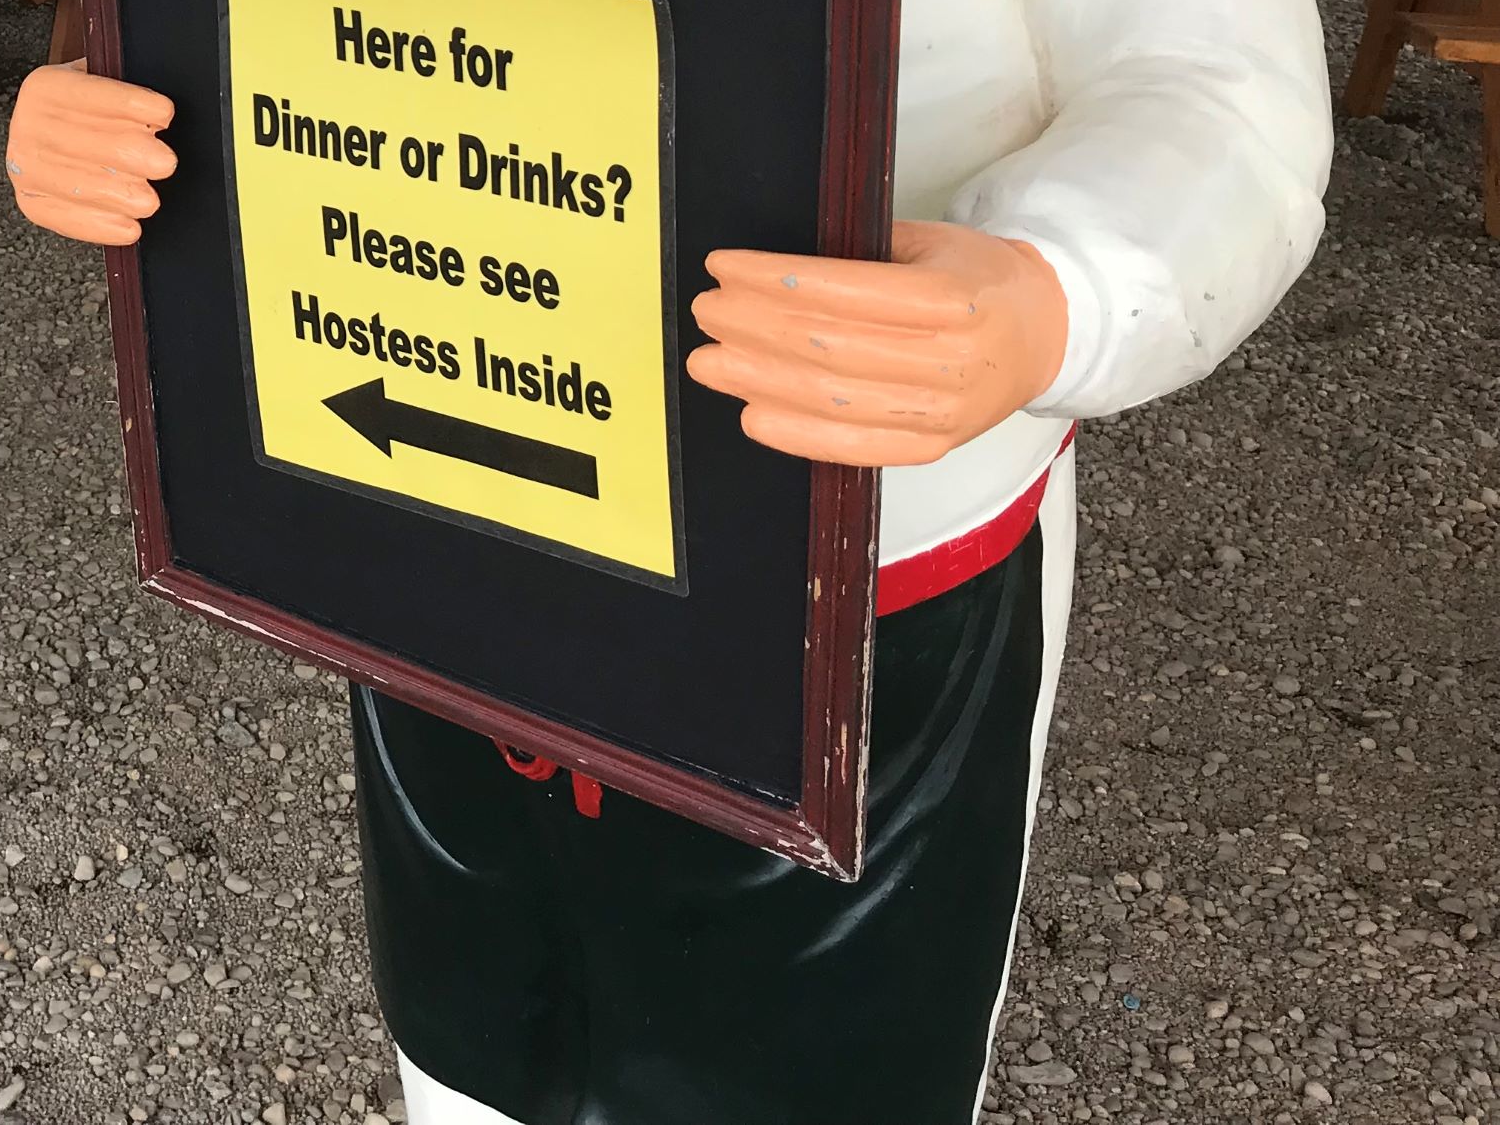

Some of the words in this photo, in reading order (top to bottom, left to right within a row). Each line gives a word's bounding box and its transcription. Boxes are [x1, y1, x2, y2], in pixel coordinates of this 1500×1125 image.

[333, 6, 437, 78] Here
[449, 27, 514, 91] for
[253, 94, 387, 170] Dinner
[400, 134, 445, 182] or
[459, 133, 633, 223] Drinks?
[322, 205, 465, 287] Please
[480, 255, 561, 310] see
[291, 290, 461, 381] Hostess
[475, 336, 613, 422] Inside
